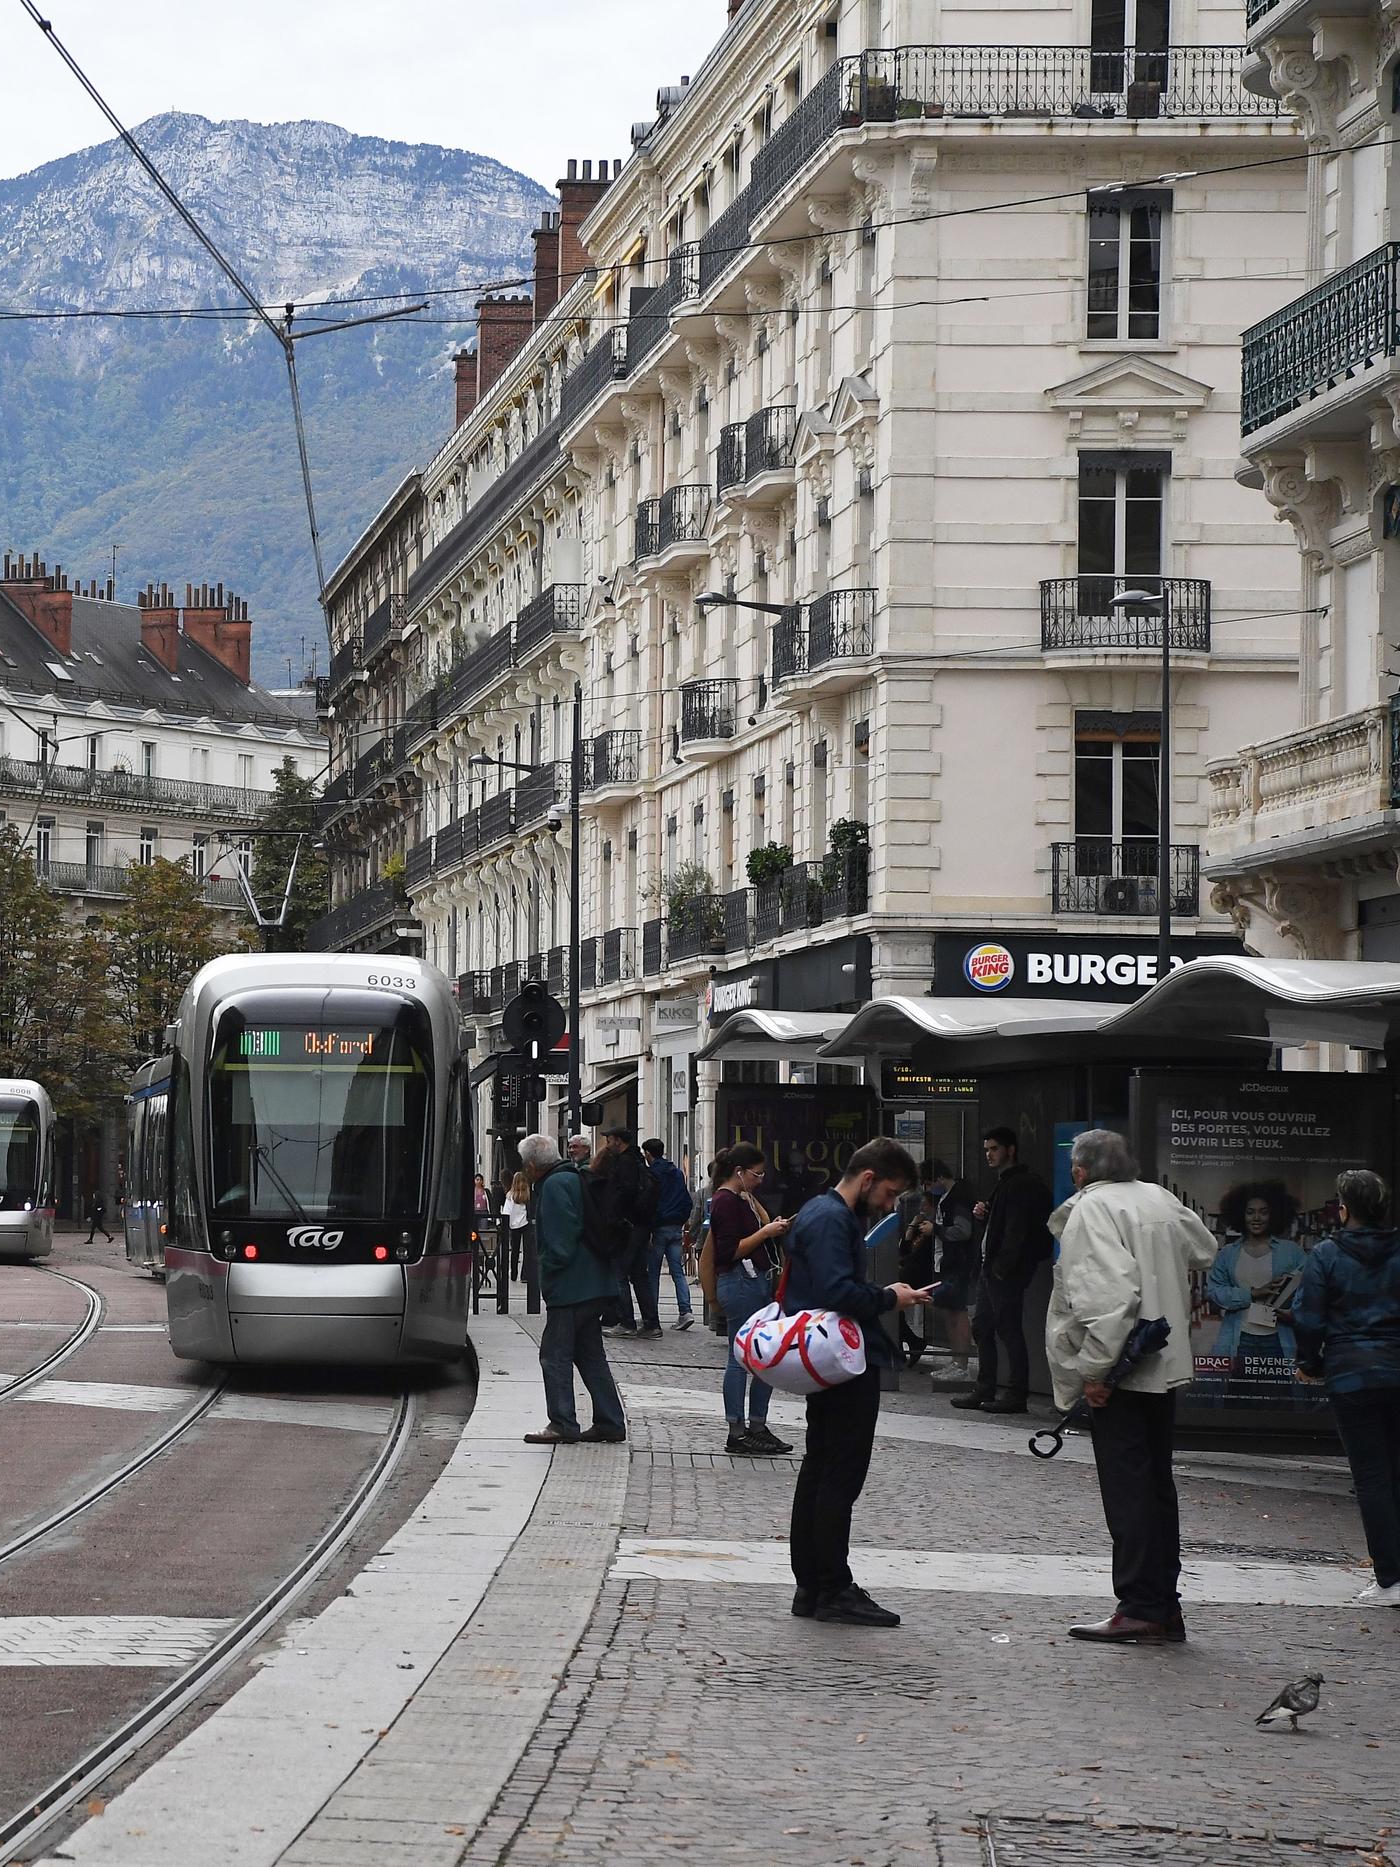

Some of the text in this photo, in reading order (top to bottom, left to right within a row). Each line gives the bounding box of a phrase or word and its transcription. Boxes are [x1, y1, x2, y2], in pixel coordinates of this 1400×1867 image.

[971, 954, 1009, 977] BURGER KING
[367, 974, 416, 989] 6033
[658, 1007, 693, 1018] KIKO
[304, 1031, 374, 1055] Oxford
[1240, 1082, 1289, 1094] JCDecaux
[501, 1095, 510, 1108] LE
[1171, 1109, 1317, 1123] ICI, POUR VOUS OUVRIR
[1171, 1123, 1331, 1137] DES PORTES, VOUS ALLEZ
[1171, 1136, 1284, 1149] OUVRIR LES YEUX.
[286, 1226, 345, 1251] Tag
[1194, 1357, 1230, 1368] IDRAC
[1244, 1356, 1296, 1367] DEVENEZ
[1244, 1367, 1297, 1376] REMARQU
